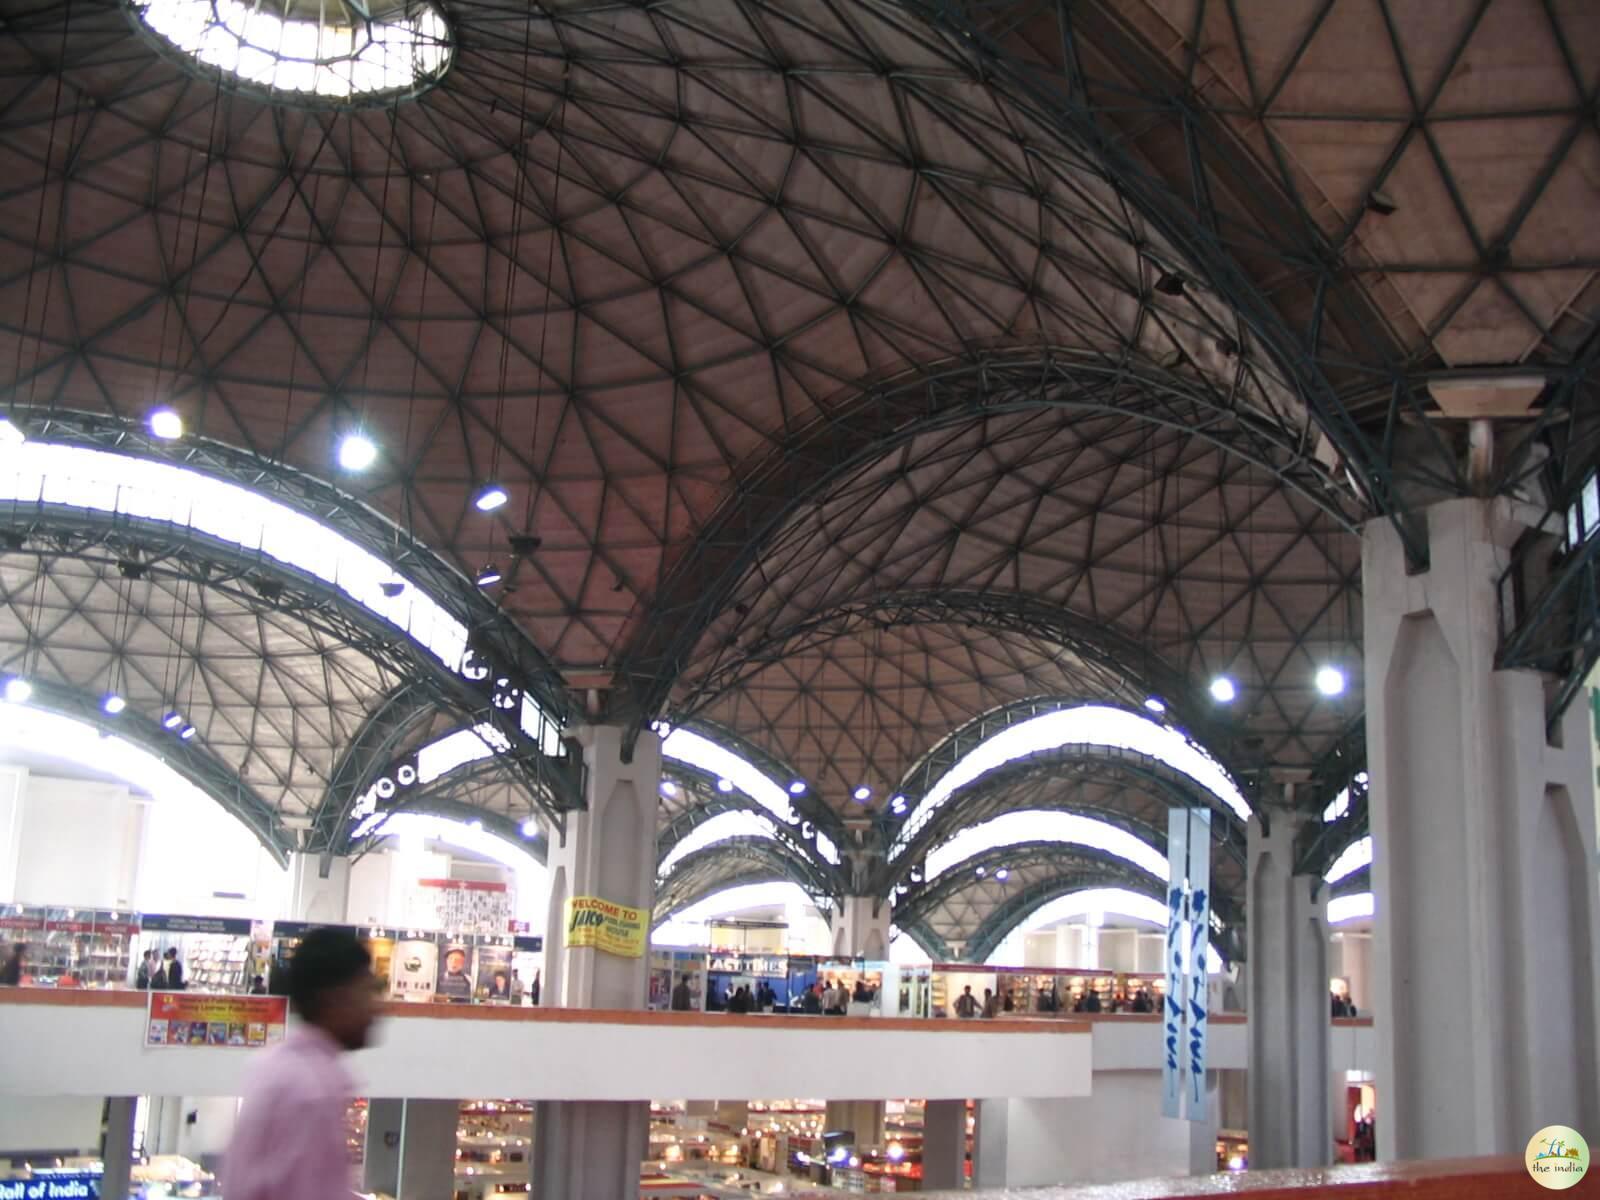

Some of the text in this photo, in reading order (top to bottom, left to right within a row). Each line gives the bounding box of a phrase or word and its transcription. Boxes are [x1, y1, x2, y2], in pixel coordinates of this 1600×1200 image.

[622, 909, 638, 921] TO
[28, 1180, 46, 1198] of
[49, 1179, 88, 1198] India
